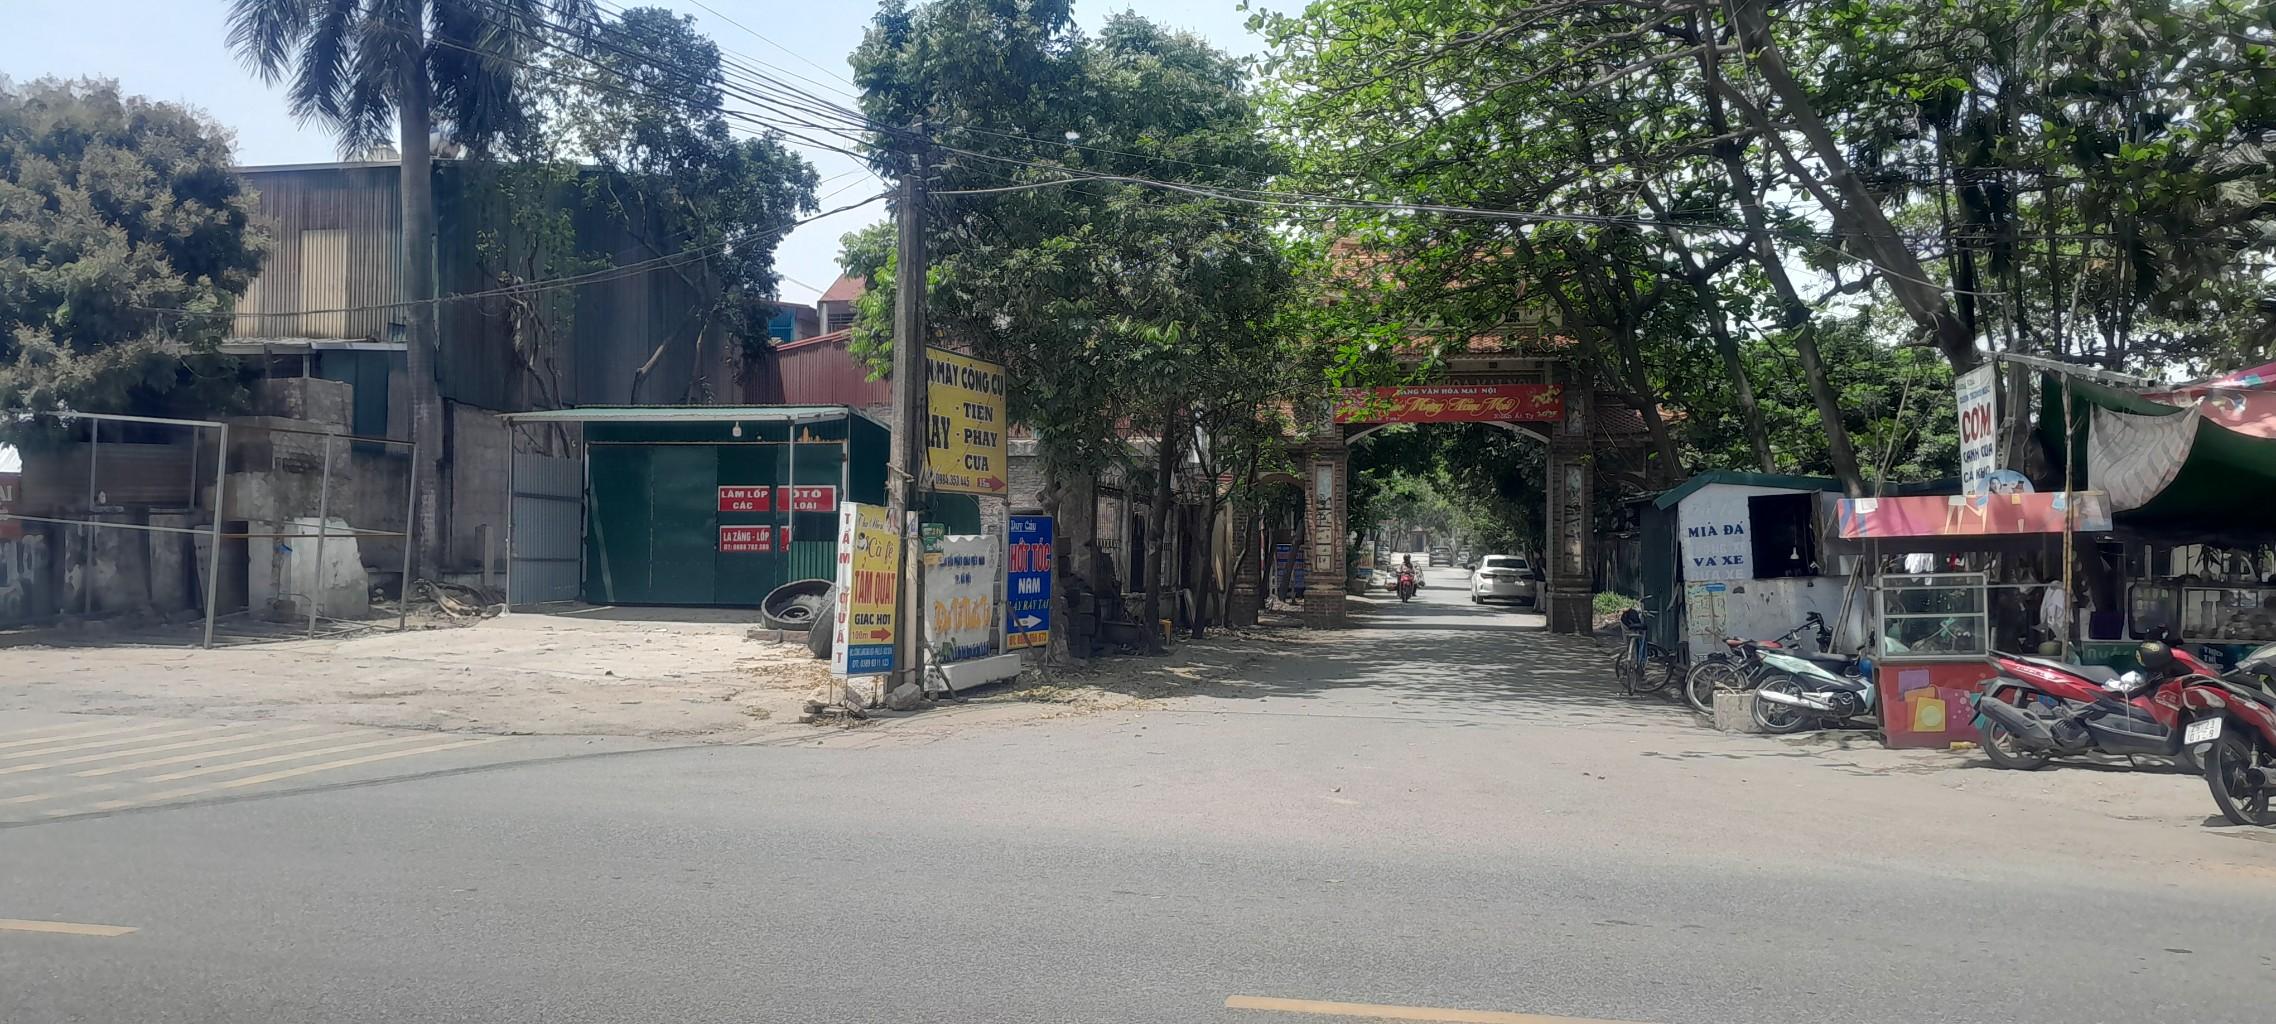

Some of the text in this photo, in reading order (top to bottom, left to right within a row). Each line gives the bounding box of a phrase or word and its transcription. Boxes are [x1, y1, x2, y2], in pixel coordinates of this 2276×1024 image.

[936, 358, 958, 386] MÁY
[961, 363, 989, 394] CÔNG
[992, 373, 1003, 401] CỤ
[1482, 386, 1497, 394] NỘI
[927, 406, 950, 449] ÁY
[1962, 402, 1991, 444] CƠM
[963, 428, 997, 447] PHAY
[747, 486, 768, 498] LỐP
[1723, 520, 1744, 535] ĐÁ
[1693, 554, 1744, 567] VÁ XE
[1018, 577, 1041, 594] NAM
